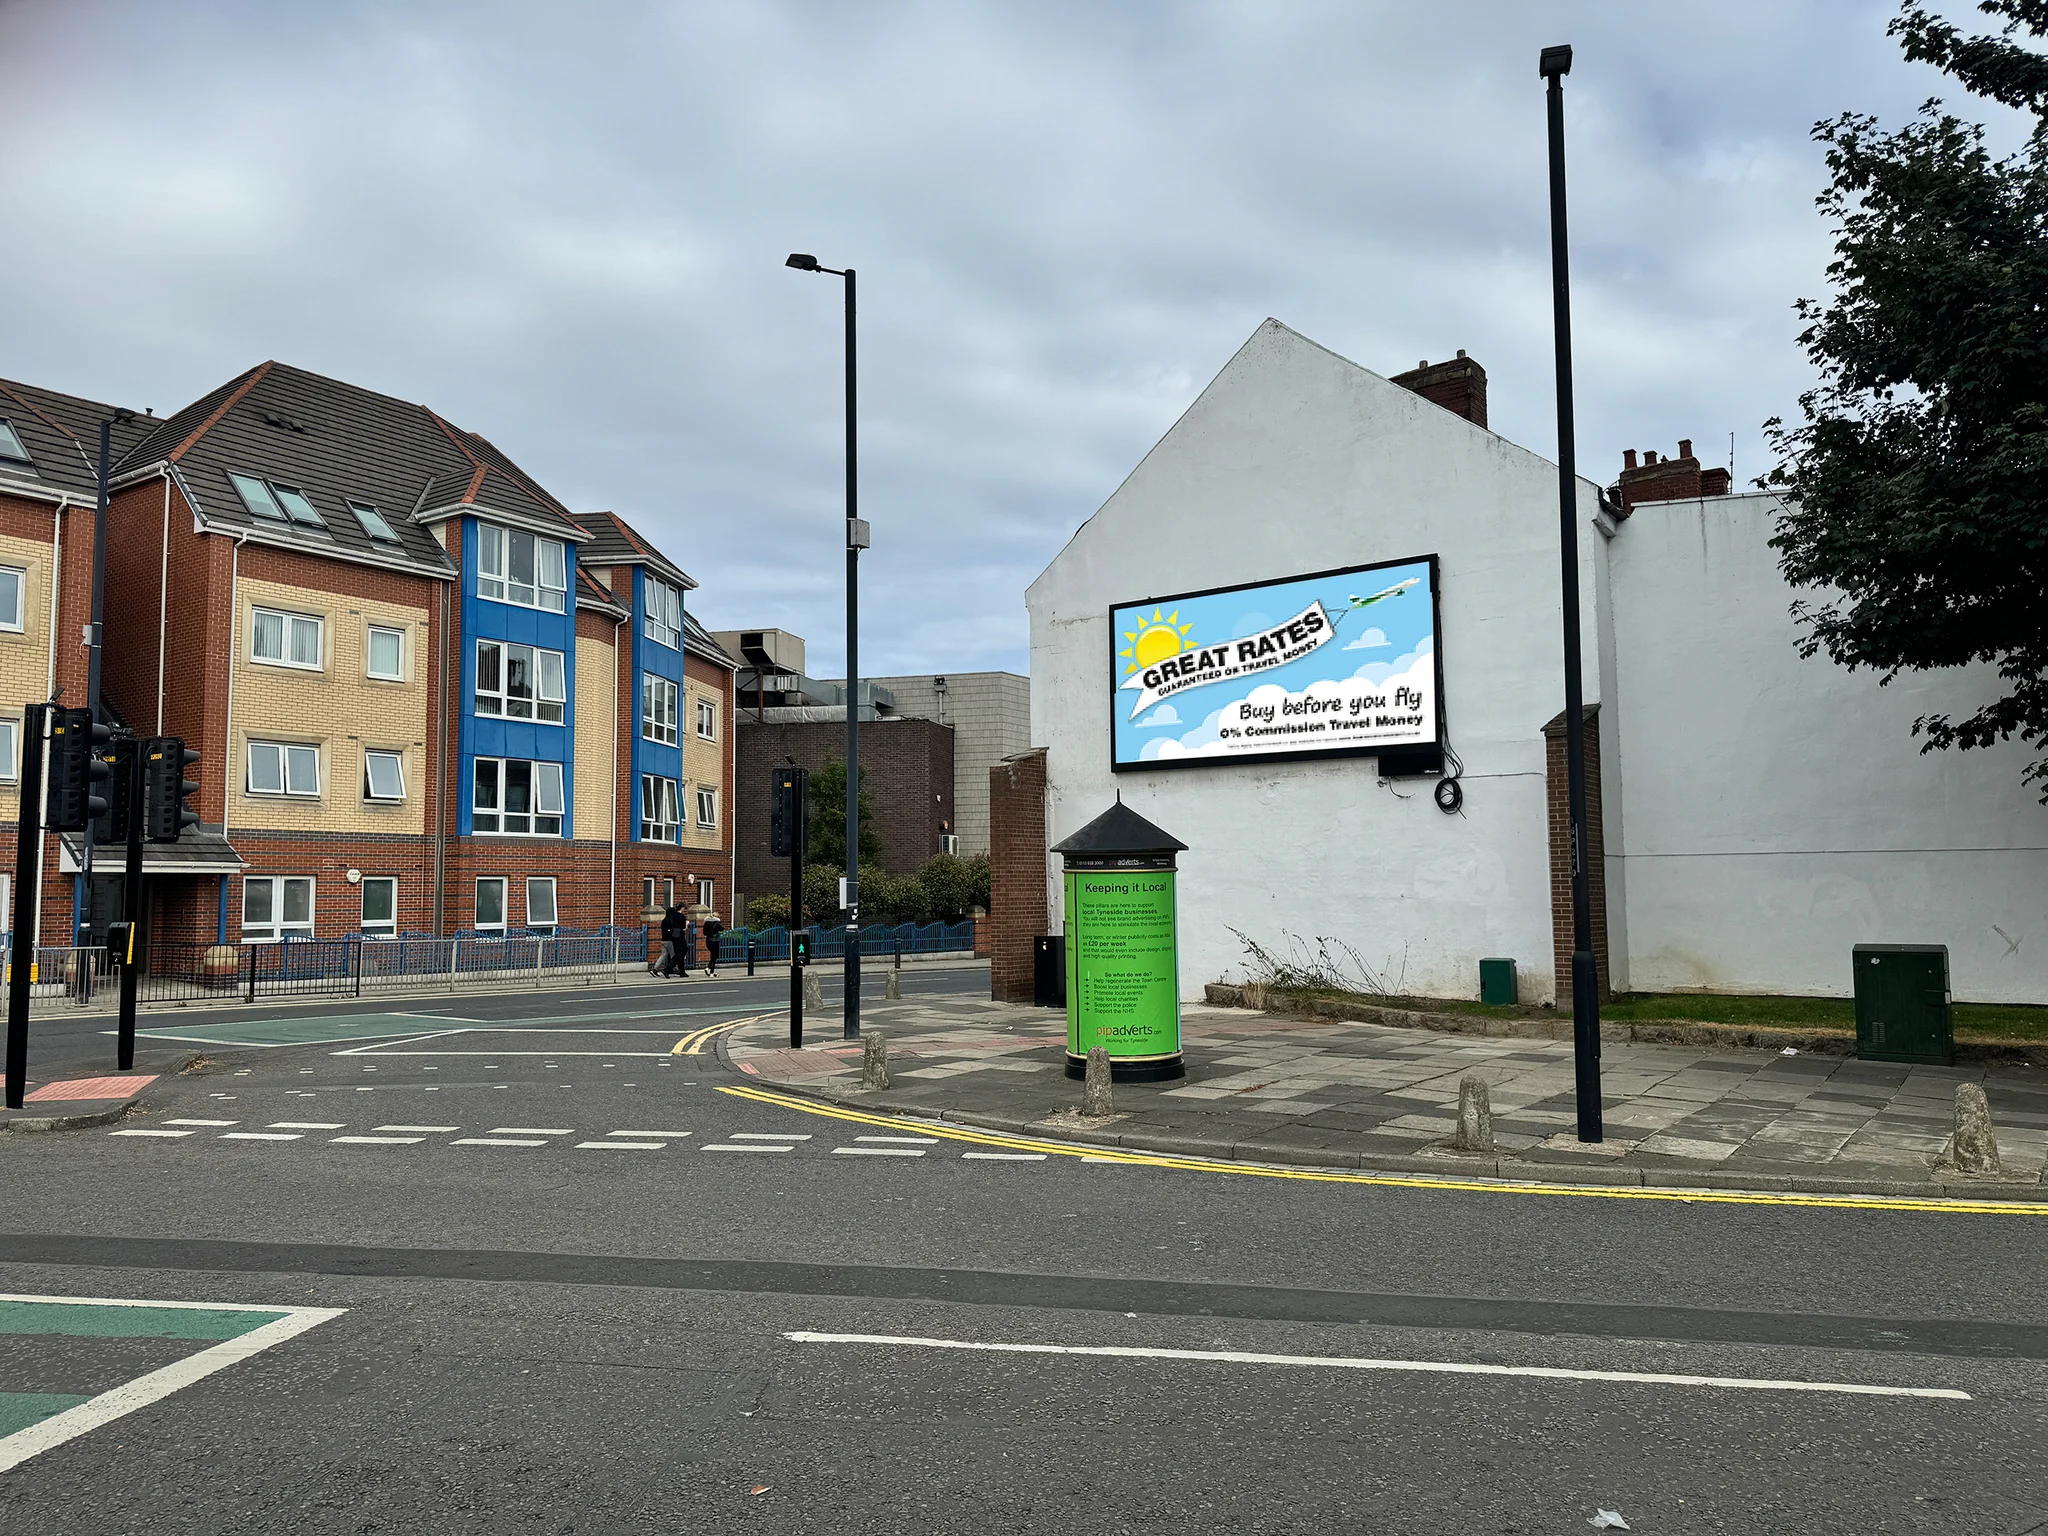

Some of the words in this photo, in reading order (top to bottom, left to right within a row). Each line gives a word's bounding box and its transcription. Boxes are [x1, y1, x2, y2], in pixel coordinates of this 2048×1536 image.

[1143, 646, 1229, 689] GREAT
[1236, 611, 1323, 662] RATES
[1158, 669, 1221, 696] GUARANTEED
[1241, 657, 1280, 672] TRAVEL
[1283, 638, 1317, 661] MONEY
[1240, 703, 1274, 722] Buy
[1283, 695, 1343, 716] before
[1350, 695, 1386, 716] you
[1394, 686, 1422, 711] fly
[1220, 727, 1241, 739] 0%
[1245, 722, 1325, 737] Commission
[1329, 716, 1370, 731] Travel
[1375, 714, 1423, 728] Money
[1085, 882, 1129, 895] Keeping
[1132, 882, 1140, 892] it
[1142, 882, 1167, 892] Local
